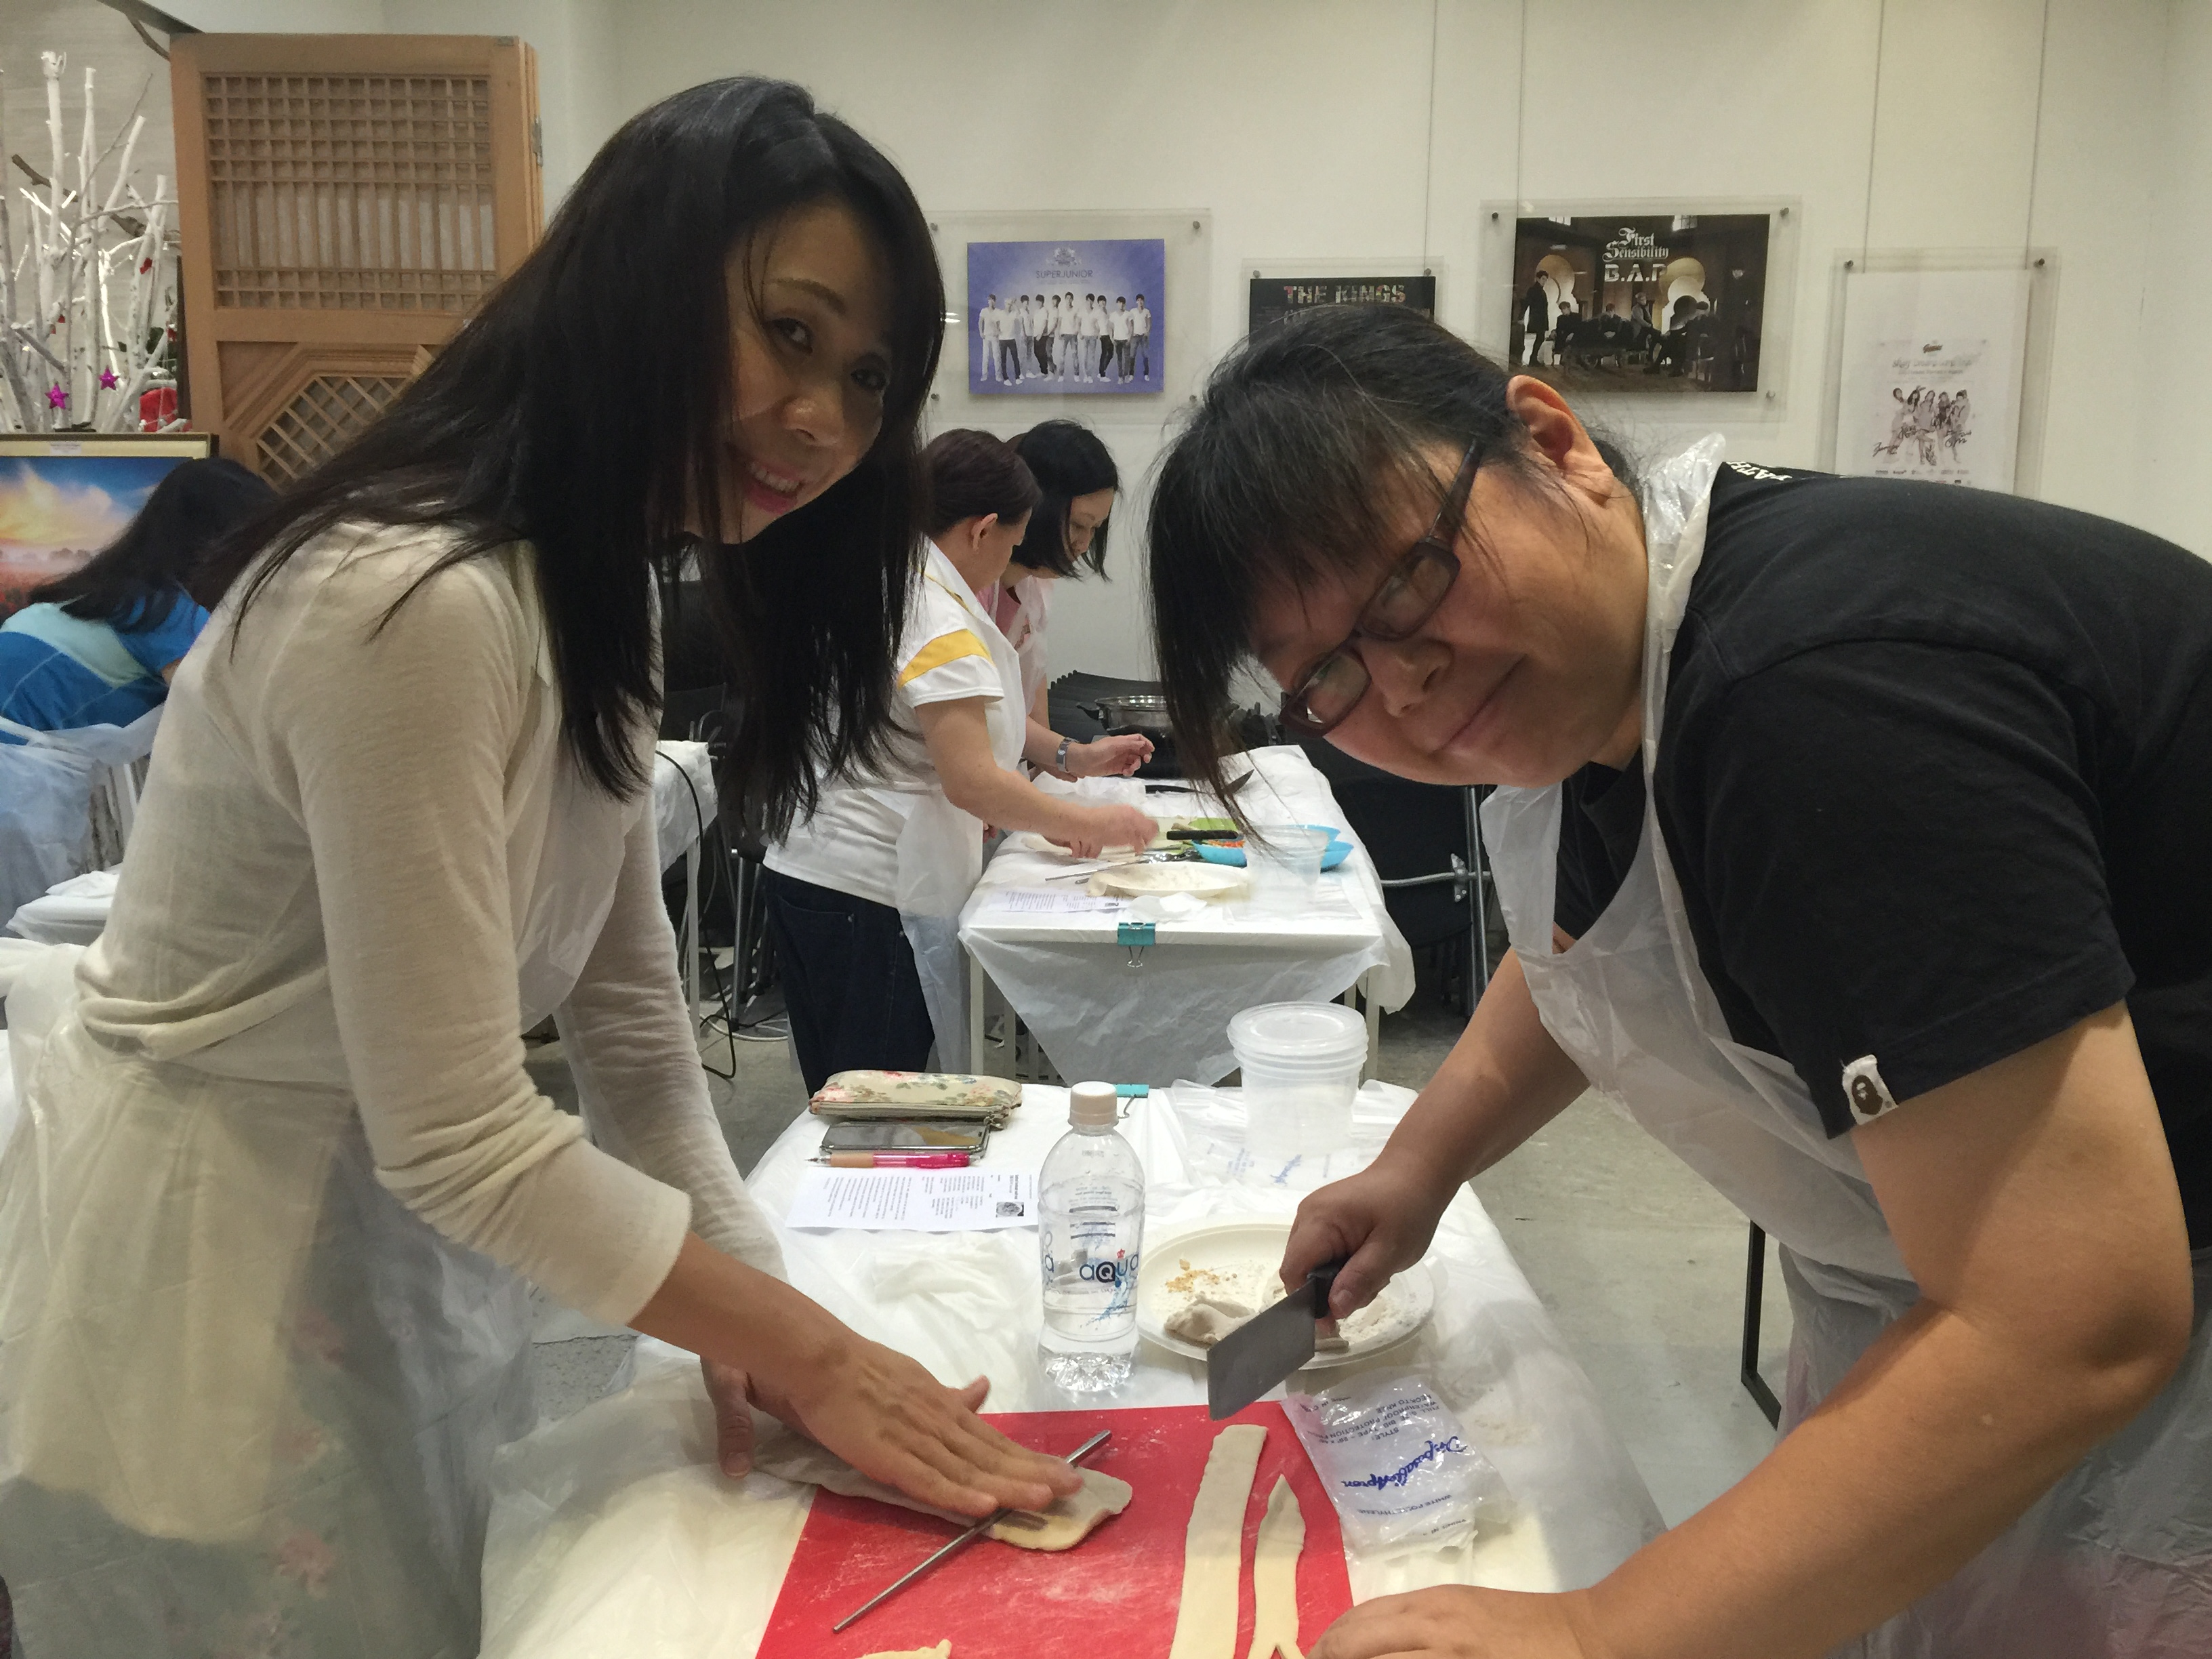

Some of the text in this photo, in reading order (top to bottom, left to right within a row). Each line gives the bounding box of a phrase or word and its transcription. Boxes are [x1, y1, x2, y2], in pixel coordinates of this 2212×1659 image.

[1618, 227, 1654, 248] First
[1602, 241, 1669, 262] Sensibility
[1284, 283, 1407, 304] THE KINGS
[1425, 1494, 1452, 1507] WHITE
